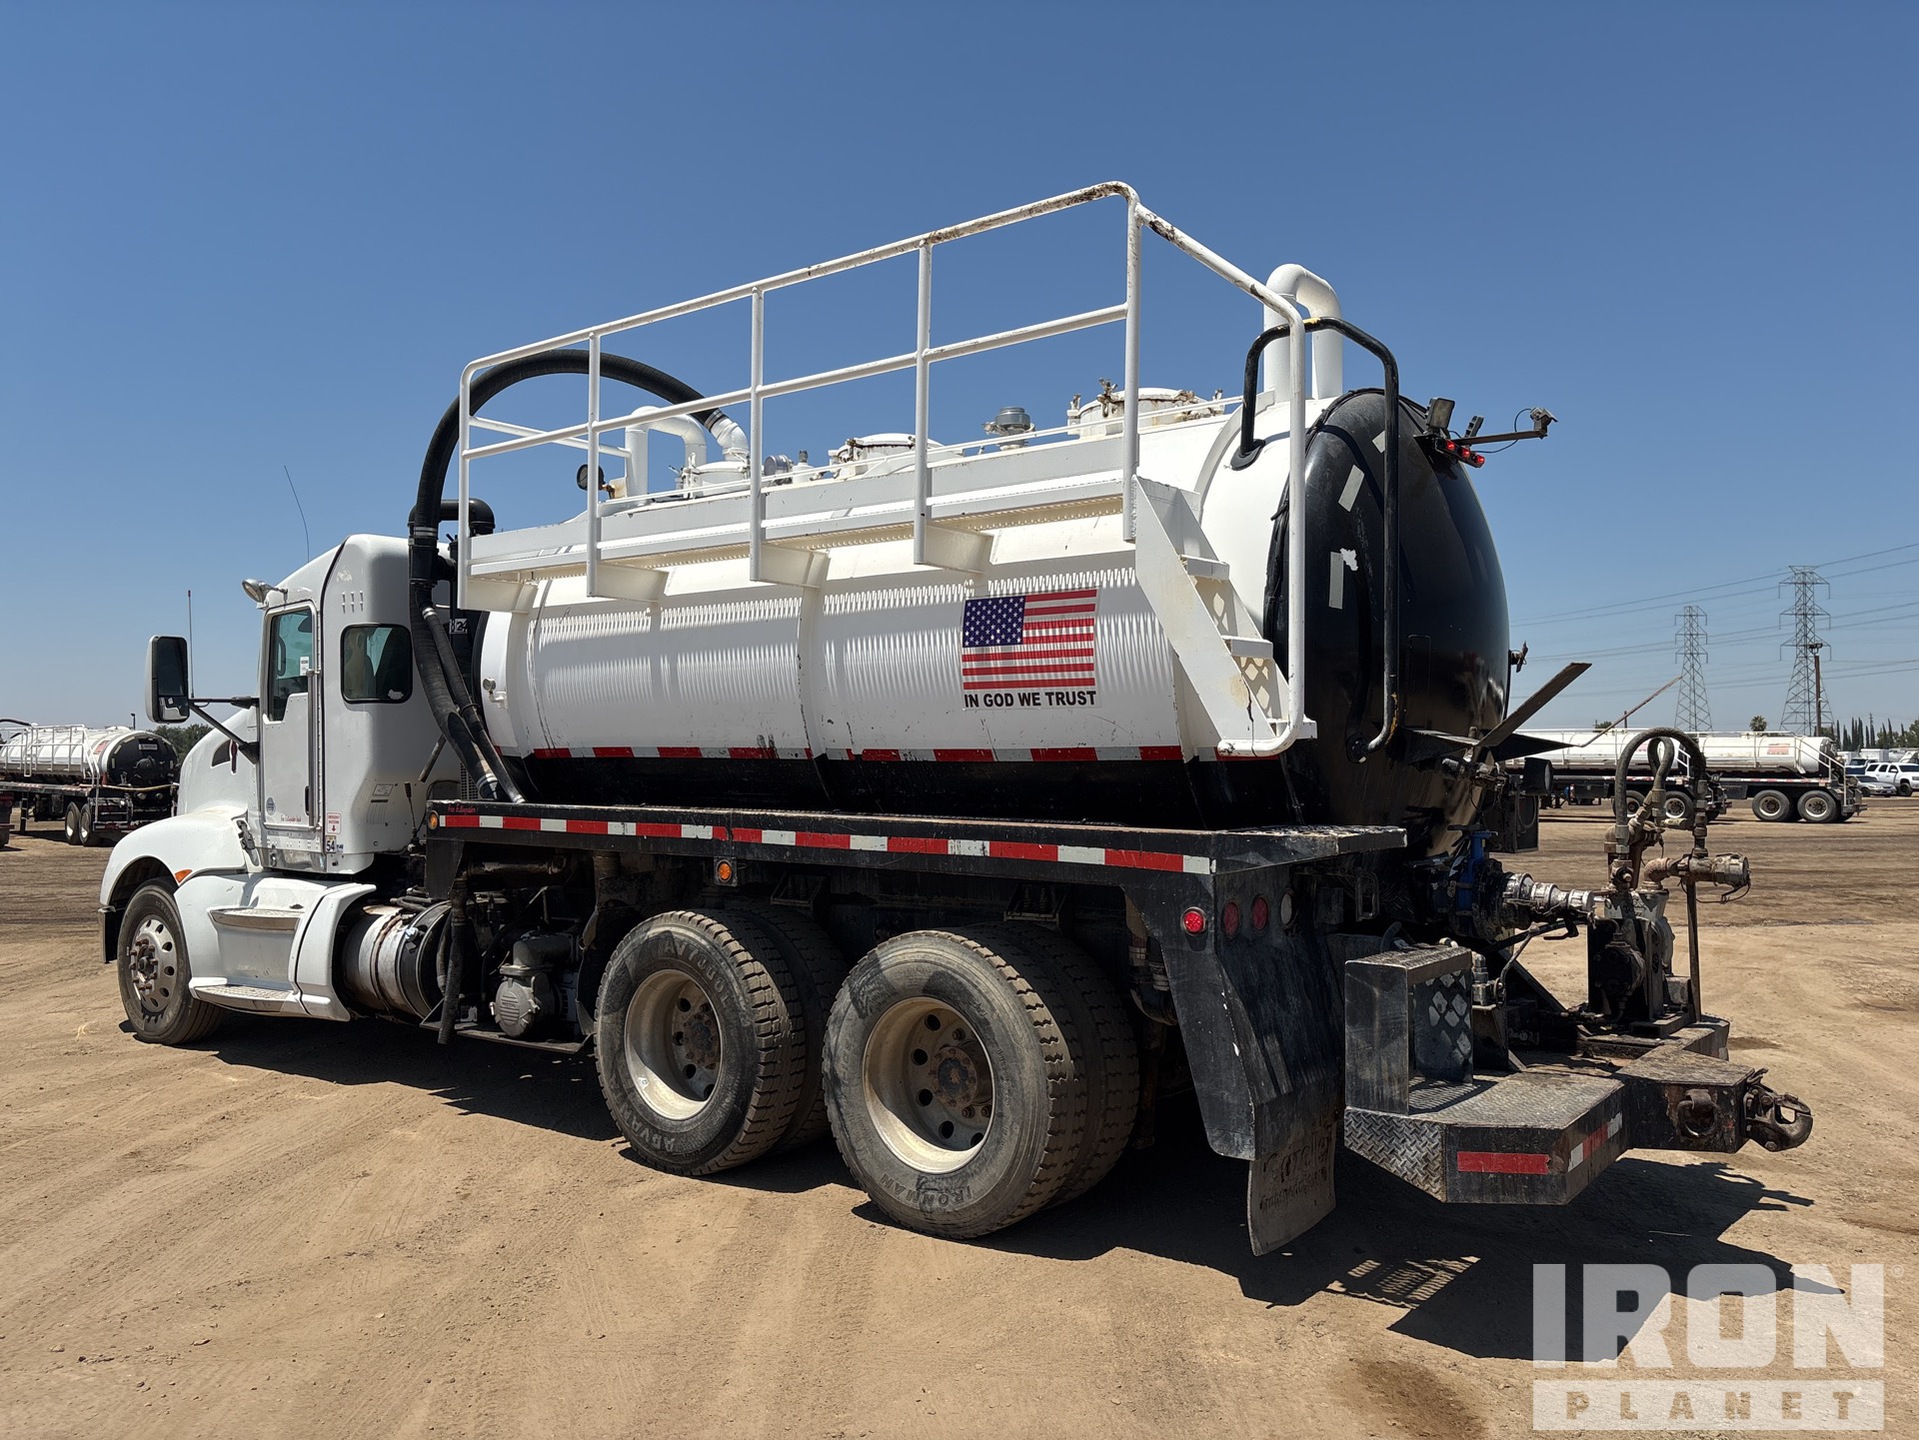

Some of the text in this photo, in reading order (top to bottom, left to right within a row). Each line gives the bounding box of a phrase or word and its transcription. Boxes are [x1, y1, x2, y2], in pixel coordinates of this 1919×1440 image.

[964, 690, 1097, 708] IN GOD WE TRUST
[326, 840, 335, 852] 54
[880, 1173, 972, 1207] IRONMAN
